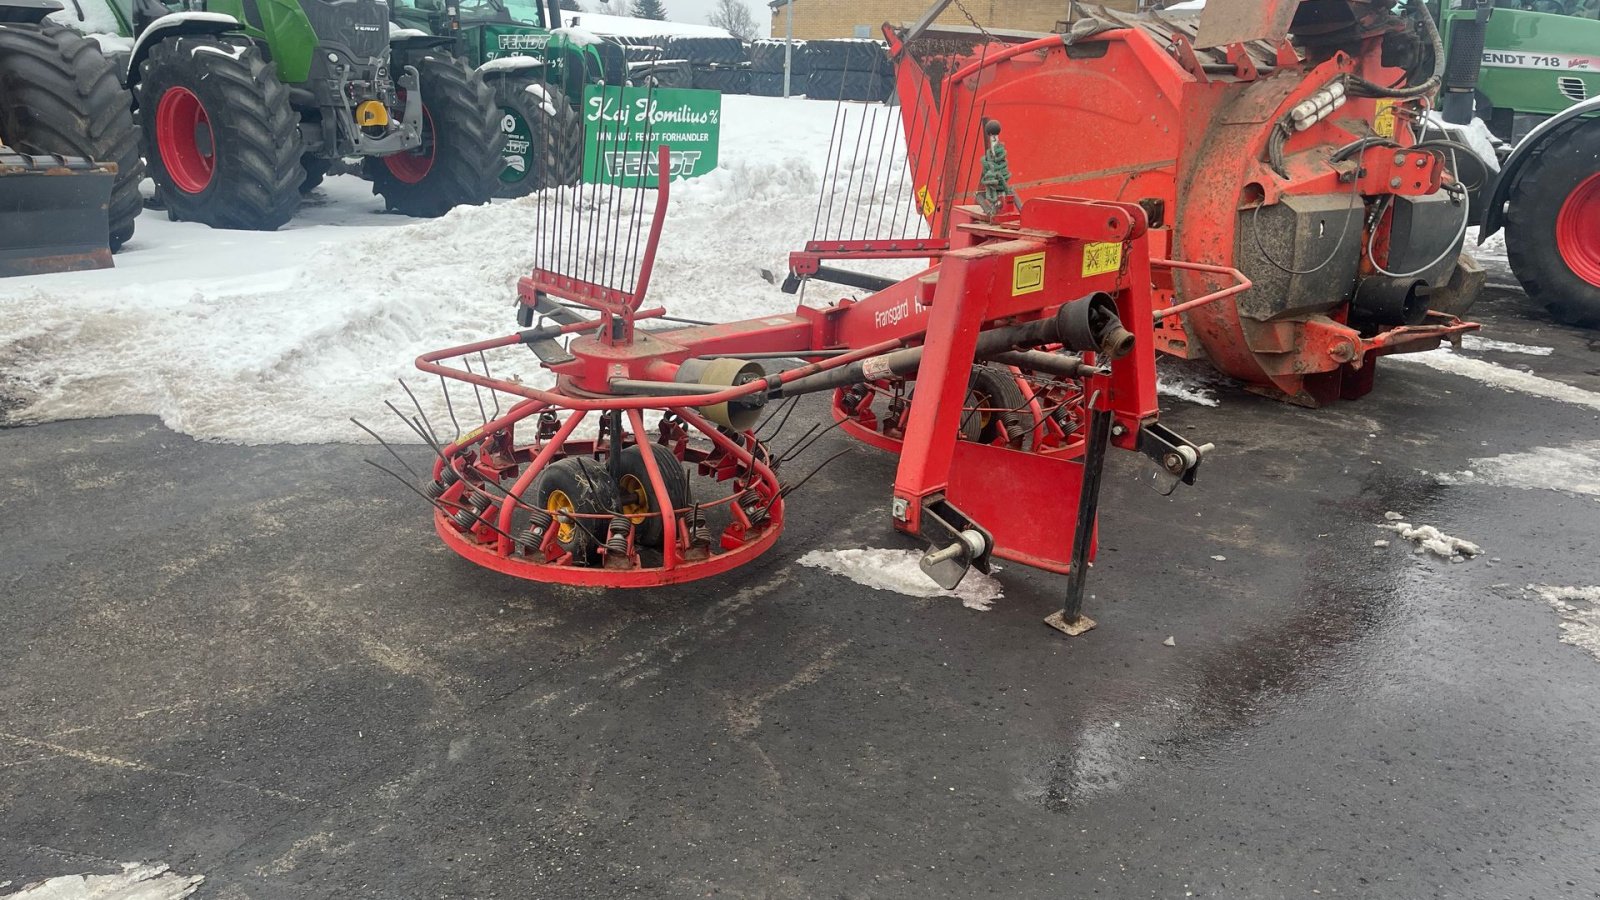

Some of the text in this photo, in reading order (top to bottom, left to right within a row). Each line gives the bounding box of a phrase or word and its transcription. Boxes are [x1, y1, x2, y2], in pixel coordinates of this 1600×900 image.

[498, 34, 552, 50] FENDT
[1482, 53, 1525, 65] ENDT
[1531, 56, 1561, 67] 718
[587, 96, 630, 126] Kaj
[635, 98, 708, 126] Homilius
[596, 132, 709, 142] DIN AUT. FENDT FORHANDLER
[605, 151, 702, 177] FENDT
[874, 298, 909, 329] Fransgård
